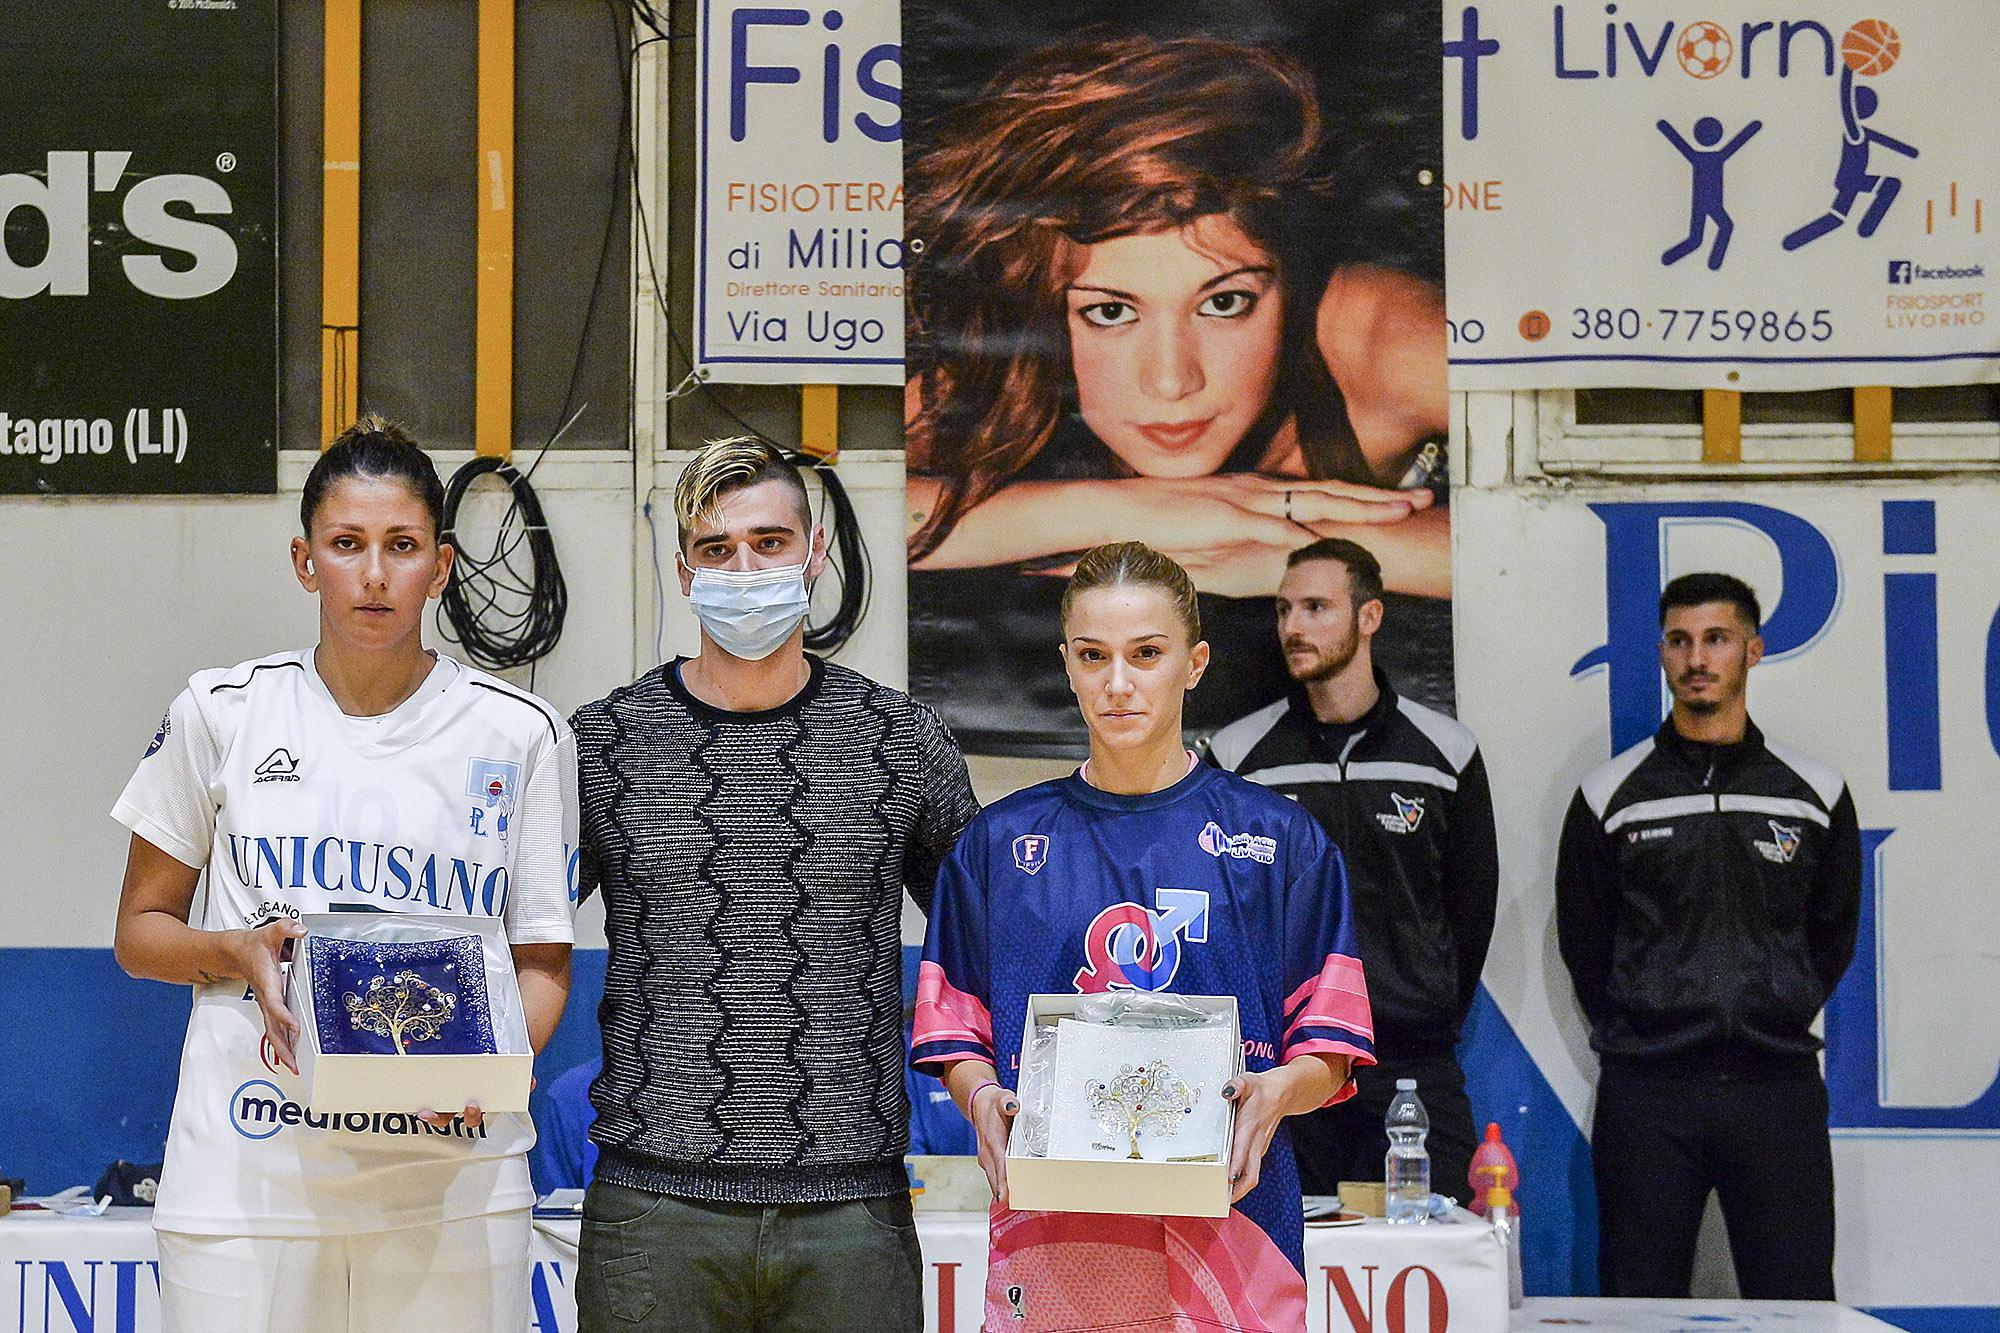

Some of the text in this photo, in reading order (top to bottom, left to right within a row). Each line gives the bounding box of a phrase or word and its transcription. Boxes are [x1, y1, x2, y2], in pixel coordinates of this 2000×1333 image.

[728, 242, 760, 269] di
[727, 281, 810, 297] Direttore
[727, 311, 787, 342] Via
[807, 310, 884, 351] Ugo
[1887, 310, 1985, 329] LIVORNO
[124, 407, 188, 464] (LI)
[228, 833, 510, 918] UNICUSANO
